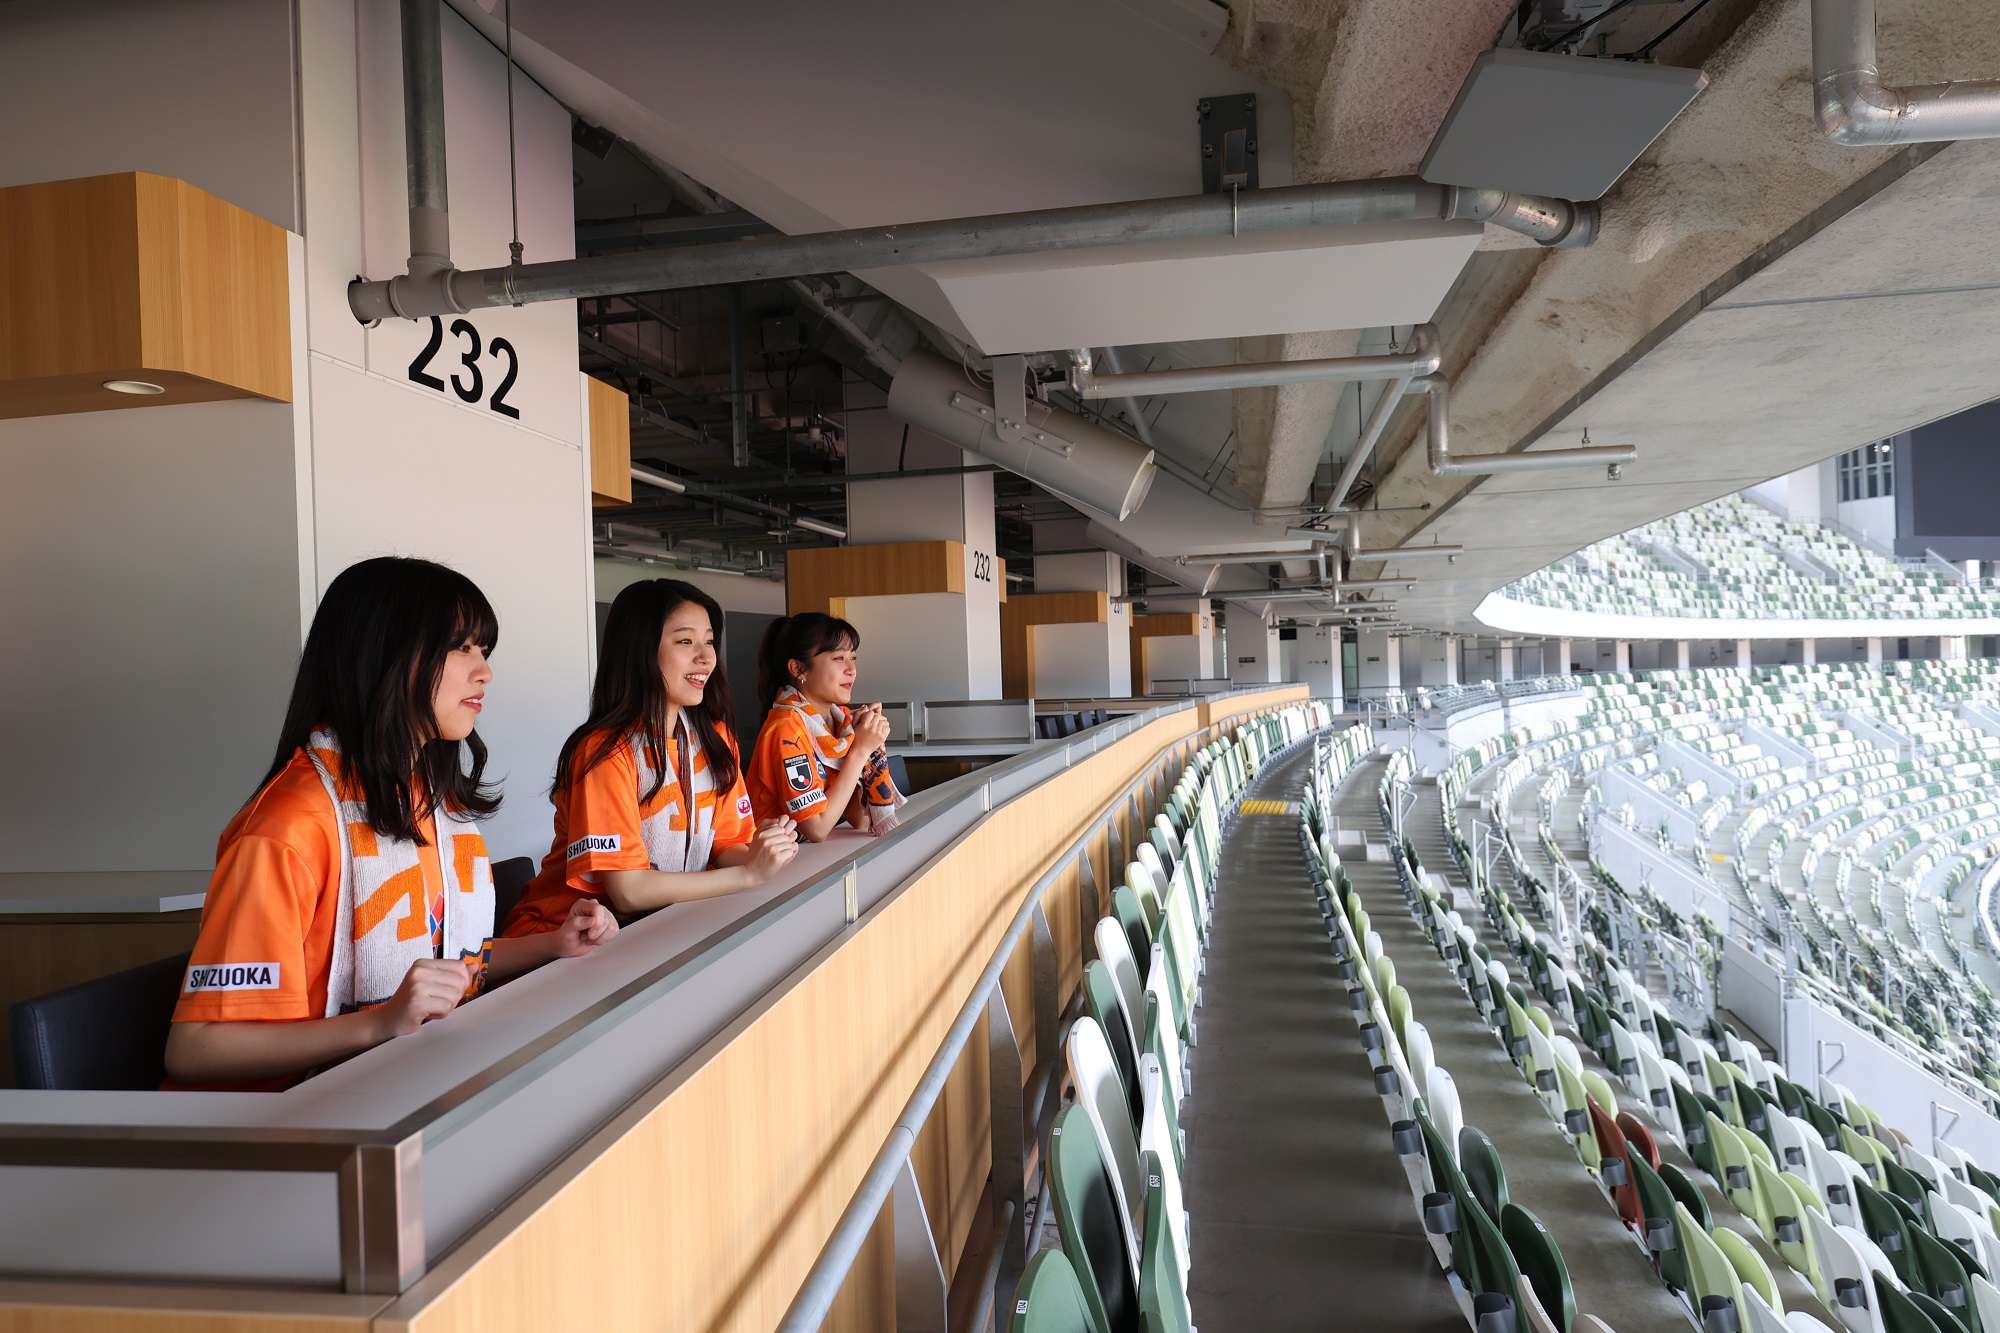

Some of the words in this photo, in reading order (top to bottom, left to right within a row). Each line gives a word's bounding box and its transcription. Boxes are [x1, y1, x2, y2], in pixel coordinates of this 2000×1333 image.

[408, 315, 520, 421] 232
[974, 550, 991, 582] 232
[568, 838, 617, 858] SHIZUOKA
[190, 967, 272, 988] SHIZUOKA
